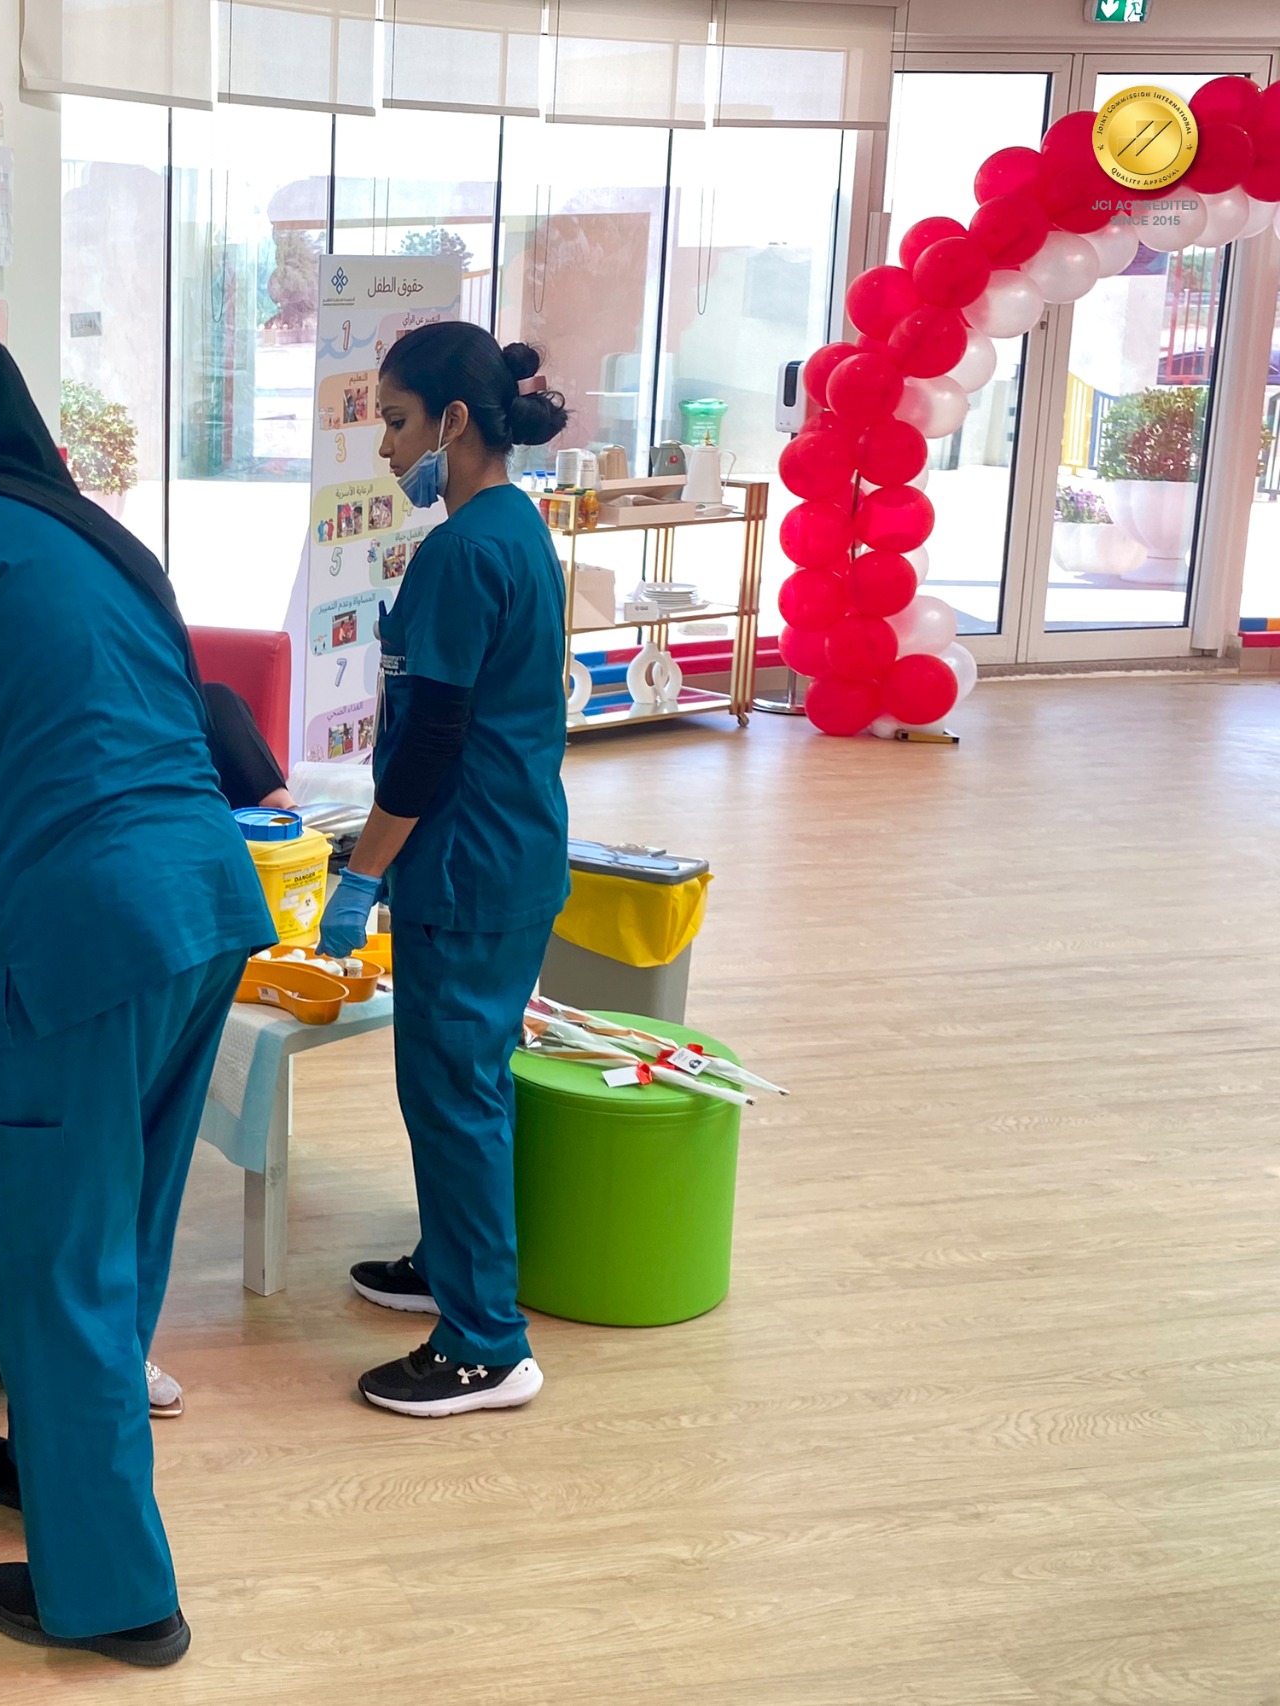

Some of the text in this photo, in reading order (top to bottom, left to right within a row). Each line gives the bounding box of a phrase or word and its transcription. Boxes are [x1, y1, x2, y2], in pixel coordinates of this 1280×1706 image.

[367, 276, 424, 298] حقوق الطفل
[342, 320, 351, 351] 1
[335, 433, 346, 463] 3
[329, 547, 343, 577] 5
[335, 658, 347, 687] 7
[294, 871, 316, 883] DANGER
